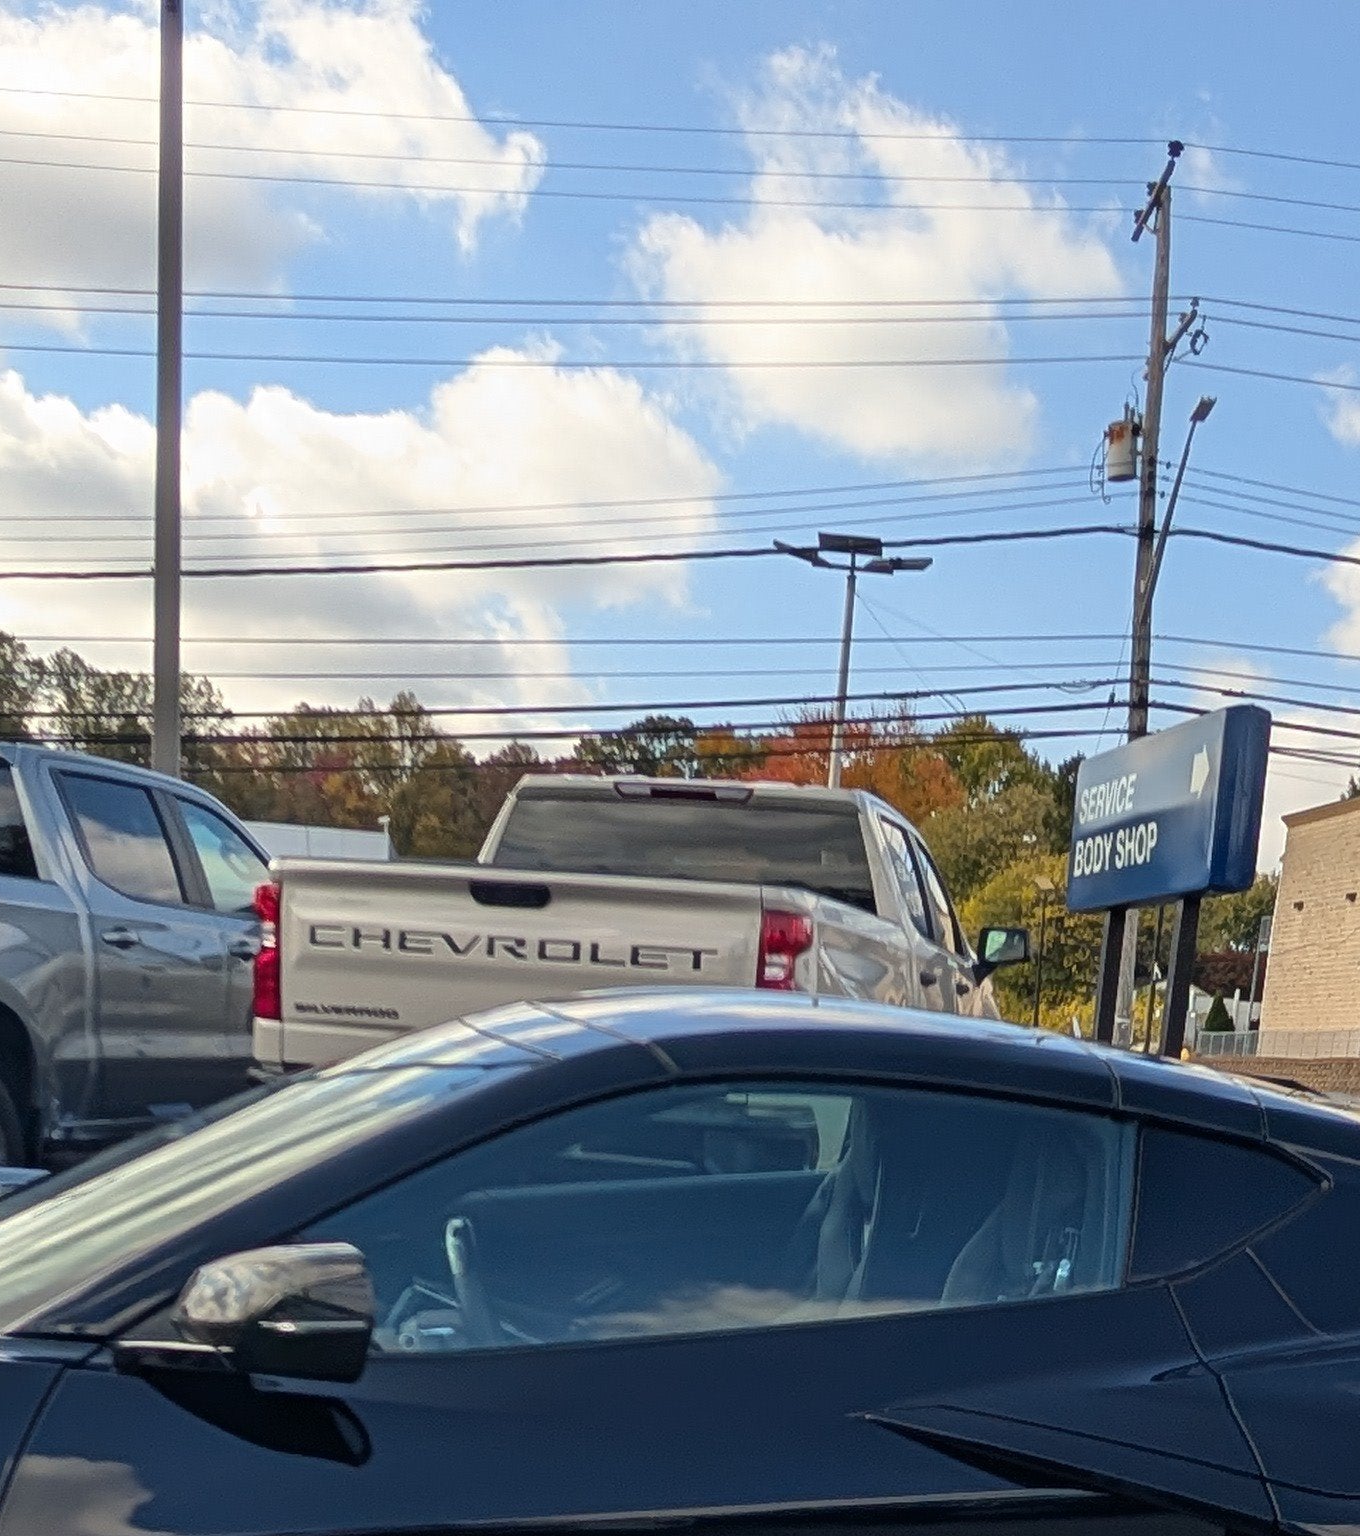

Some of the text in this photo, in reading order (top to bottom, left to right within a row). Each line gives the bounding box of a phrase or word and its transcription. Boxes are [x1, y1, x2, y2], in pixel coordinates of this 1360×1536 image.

[1079, 773, 1137, 825] SERVICE
[1073, 821, 1158, 878] BODY SHOP
[308, 923, 719, 971] CHEVROLET
